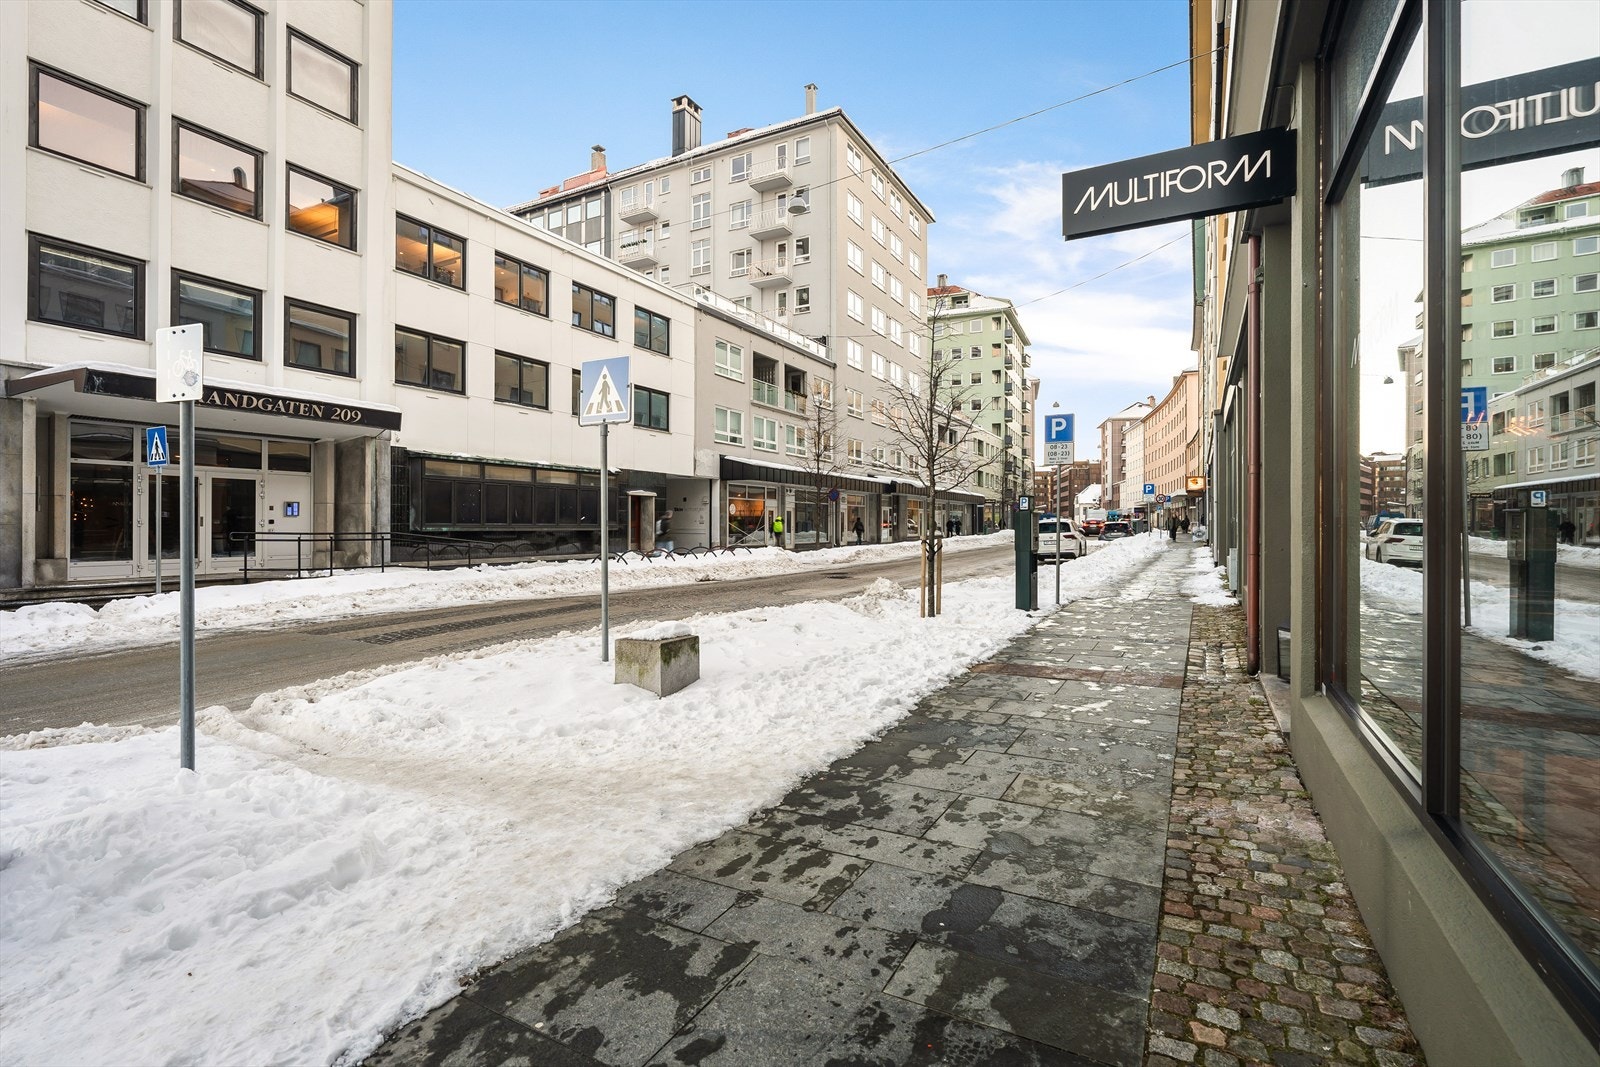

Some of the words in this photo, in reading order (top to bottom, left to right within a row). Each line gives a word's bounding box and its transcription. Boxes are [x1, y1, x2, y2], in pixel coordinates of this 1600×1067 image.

[1073, 149, 1271, 215] MULTIFORM
[198, 390, 325, 418] ANDGATEN
[331, 407, 362, 423] 209
[1051, 417, 1067, 439] P
[1145, 485, 1153, 493] P
[1021, 498, 1027, 506] P
